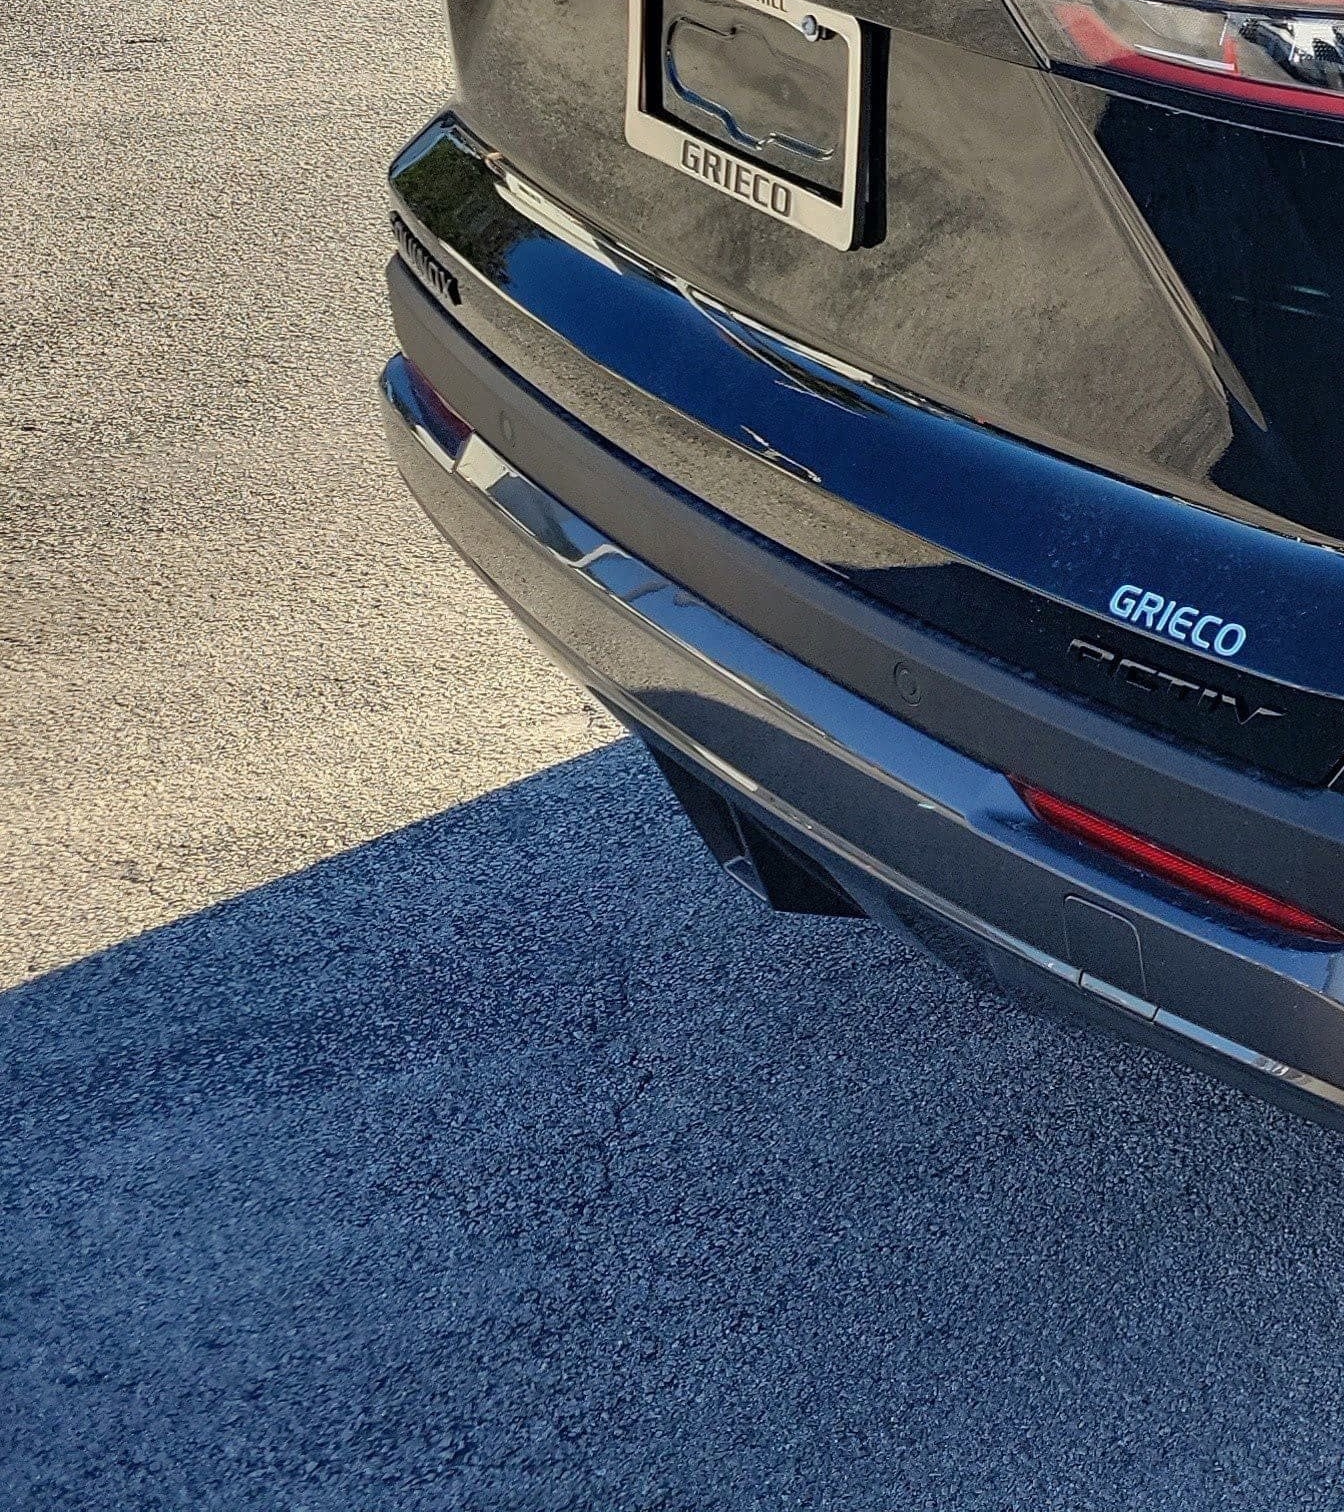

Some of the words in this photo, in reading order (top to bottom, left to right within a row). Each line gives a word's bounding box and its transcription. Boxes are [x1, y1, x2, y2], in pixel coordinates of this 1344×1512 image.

[681, 138, 792, 219] GRIECO
[1109, 584, 1247, 657] GRIECO
[1067, 638, 1287, 725] ACTIV
